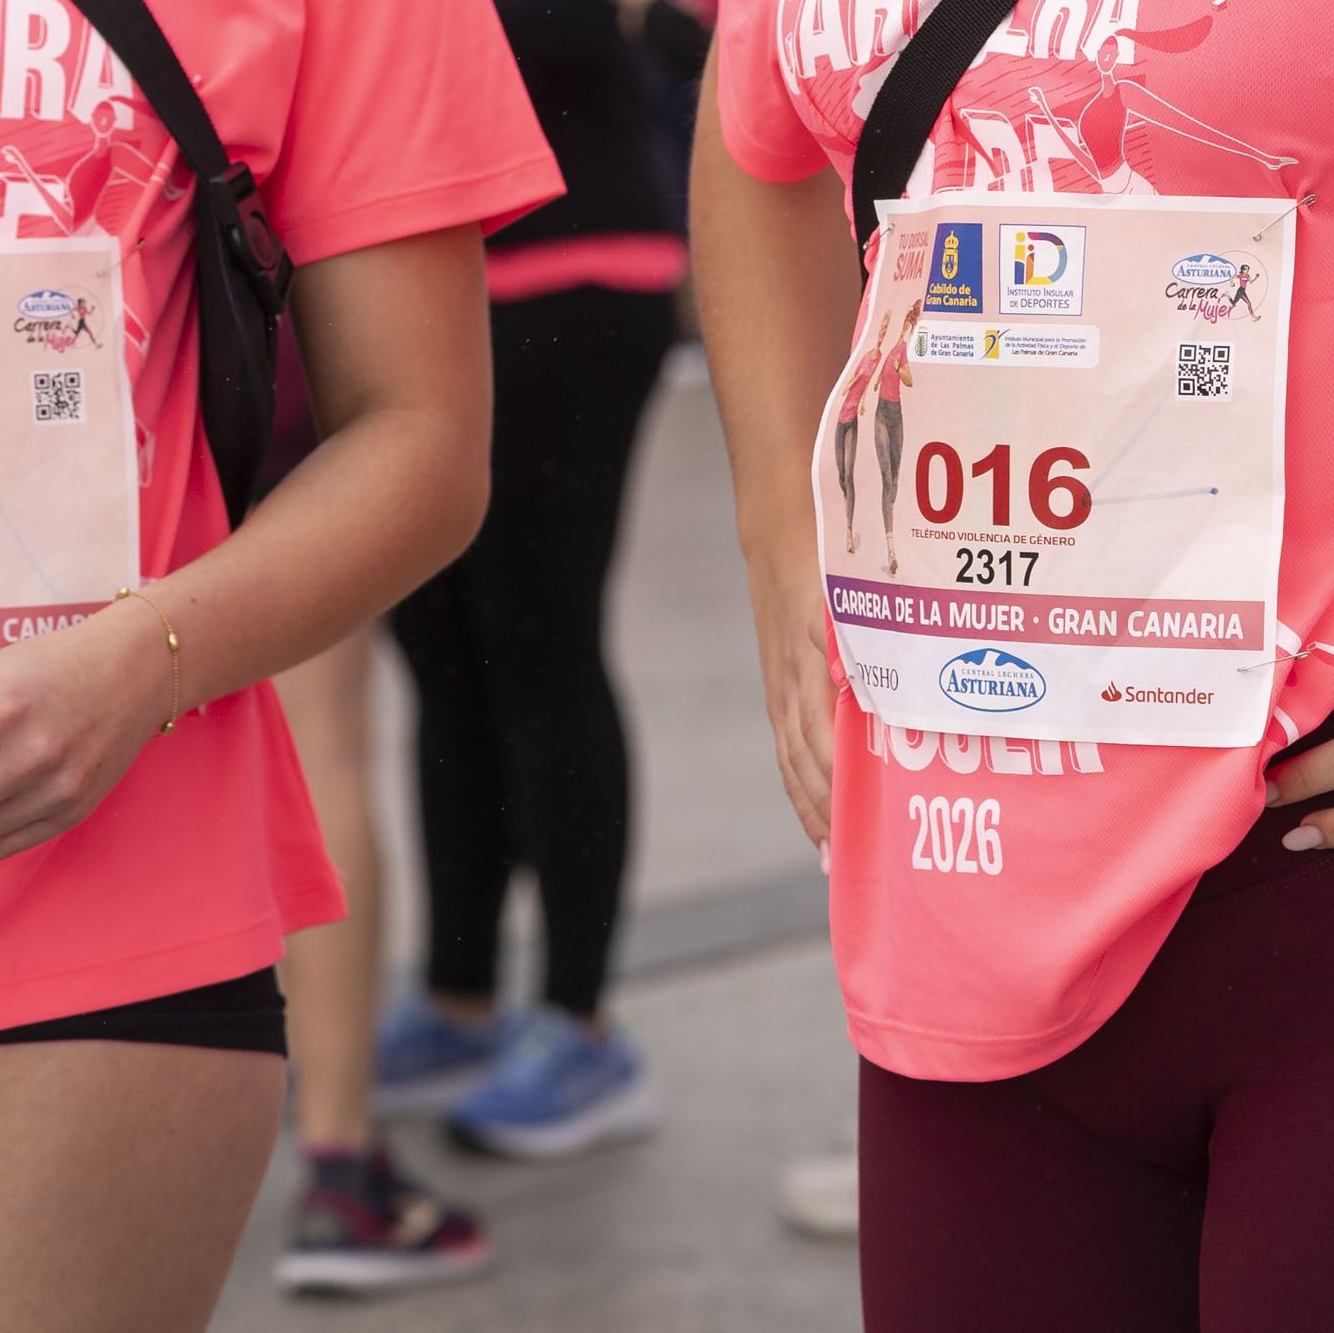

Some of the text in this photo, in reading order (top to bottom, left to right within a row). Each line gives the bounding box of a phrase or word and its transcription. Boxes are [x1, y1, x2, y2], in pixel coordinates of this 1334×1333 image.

[893, 251, 926, 282] SUMA
[1176, 265, 1233, 279] ASTURIANA
[929, 283, 971, 295] Cabildo de
[1007, 286, 1074, 298] INSTITUTO INSULAR
[1164, 282, 1219, 300] Carrera
[926, 295, 978, 306] Gran Canaria
[1020, 298, 1070, 309] DEPORTES
[1177, 294, 1237, 324] de la Mujer
[915, 441, 1093, 531] 016
[911, 528, 1076, 547] TELÉFONO VIOLENCIA DE GÉNERO
[955, 548, 1040, 587] 2317
[833, 586, 1245, 641] CARRERA DE LA MUJER GRAN CANARIA
[947, 669, 1038, 698] ASTURIANA
[961, 668, 1035, 680] CENTRAL LECHERA
[1125, 685, 1215, 706] Santander
[908, 794, 1004, 876] 2026
